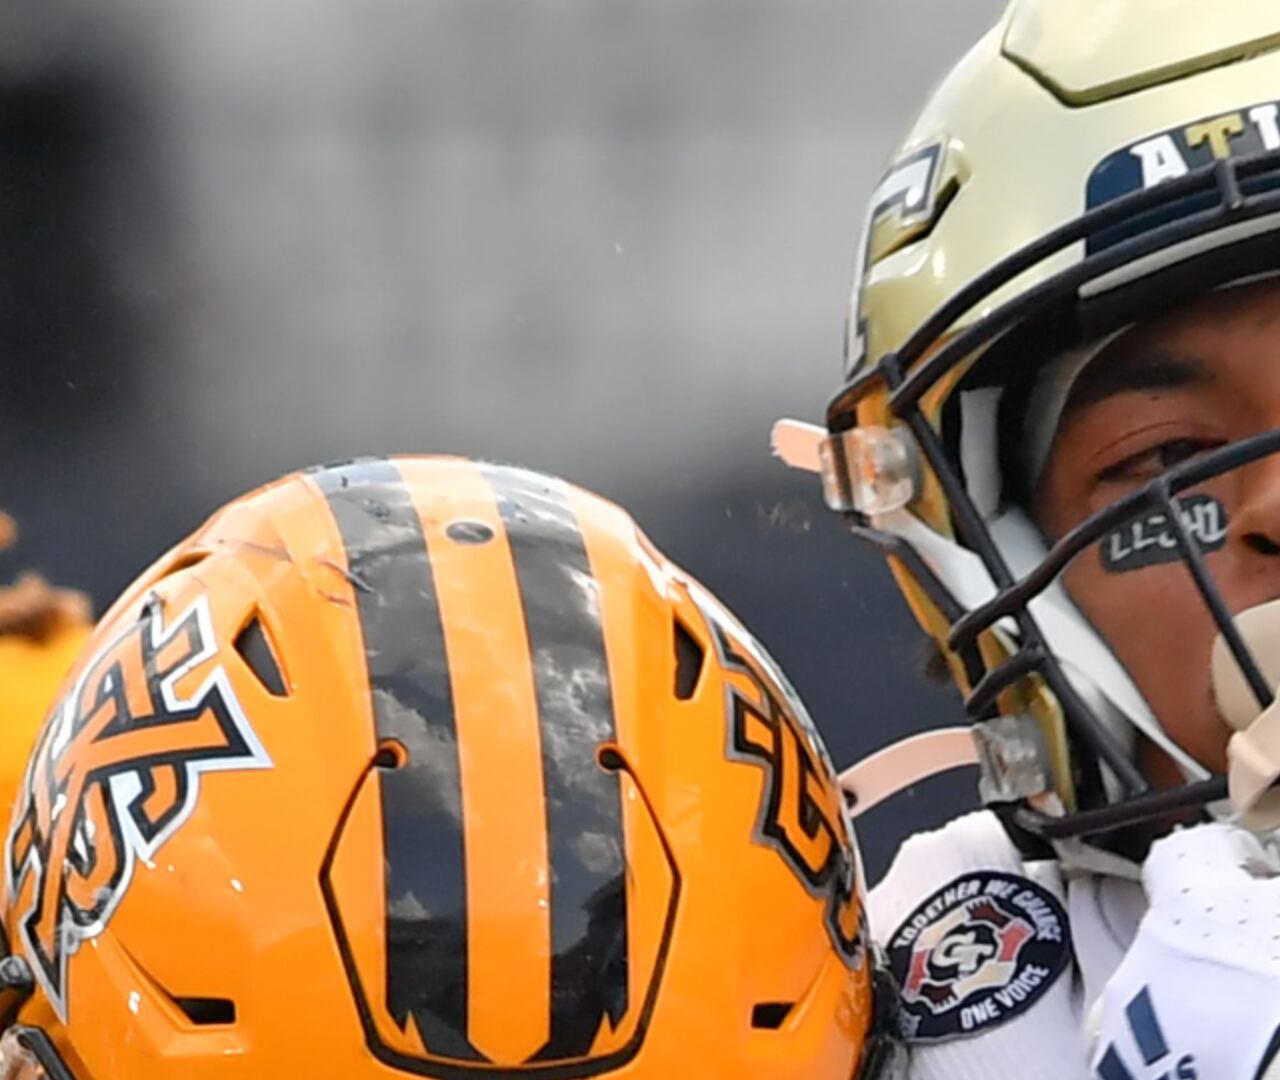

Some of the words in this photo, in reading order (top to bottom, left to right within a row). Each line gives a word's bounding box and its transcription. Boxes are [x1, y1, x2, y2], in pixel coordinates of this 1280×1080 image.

[894, 880, 981, 949] TOGETHER
[960, 1002, 1000, 1030] ONE
[995, 963, 1049, 1008] VOICE
